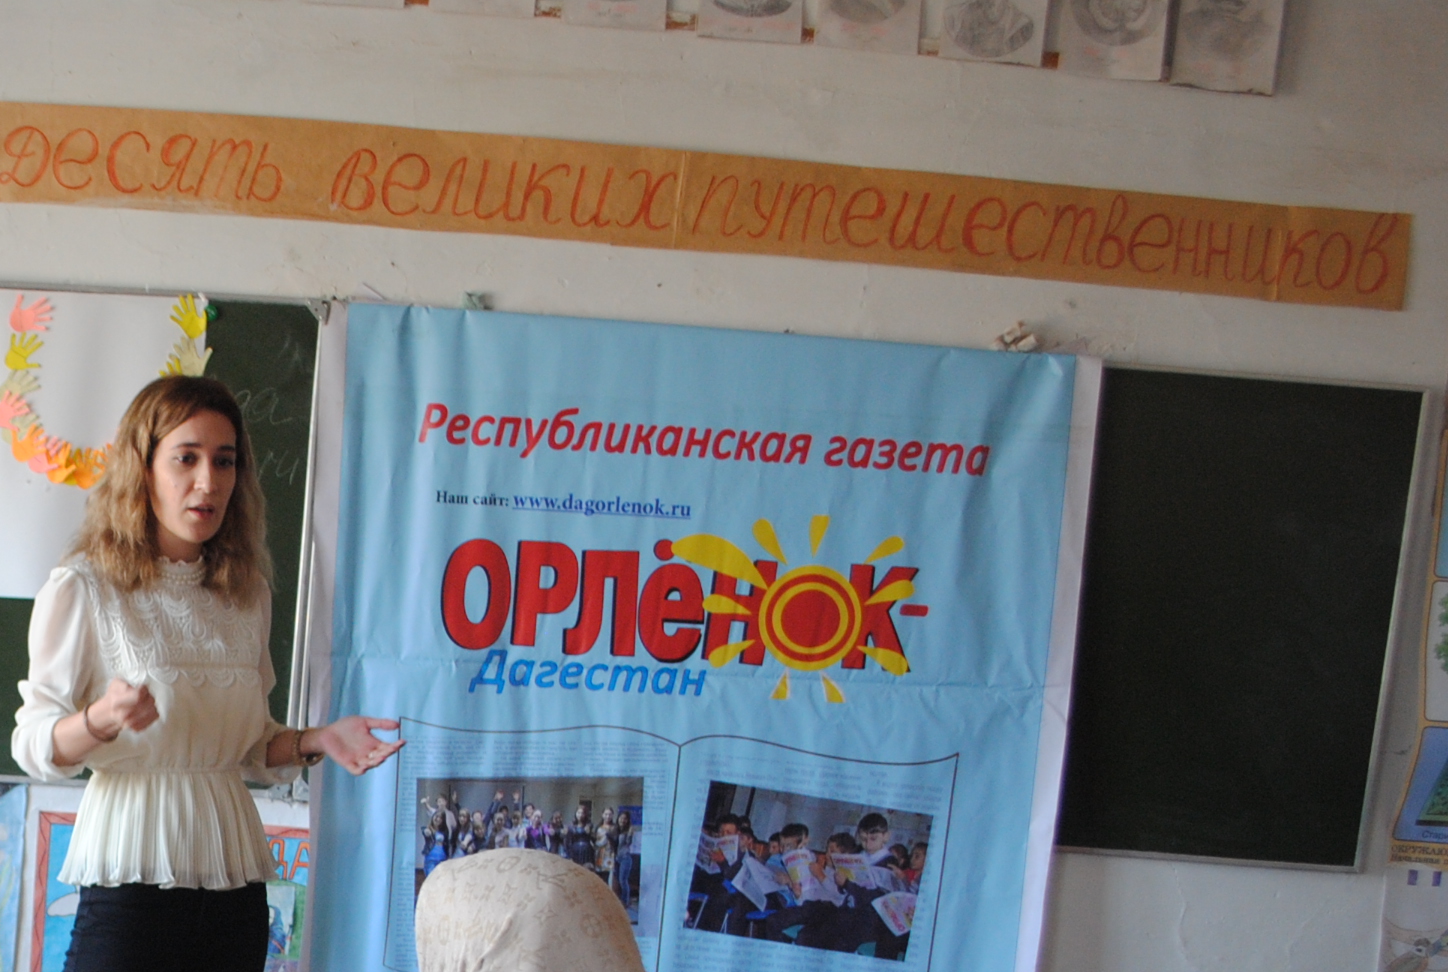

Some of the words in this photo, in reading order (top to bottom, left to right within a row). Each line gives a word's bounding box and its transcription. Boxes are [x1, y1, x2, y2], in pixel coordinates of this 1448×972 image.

[691, 173, 1399, 296] путешественников
[417, 402, 813, 465] Республиканская
[823, 434, 991, 478] газета
[436, 490, 468, 505] Наш
[473, 494, 509, 507] сайт:
[512, 494, 691, 519] www.dagorlenok.ru
[467, 648, 709, 699] Дагестан
